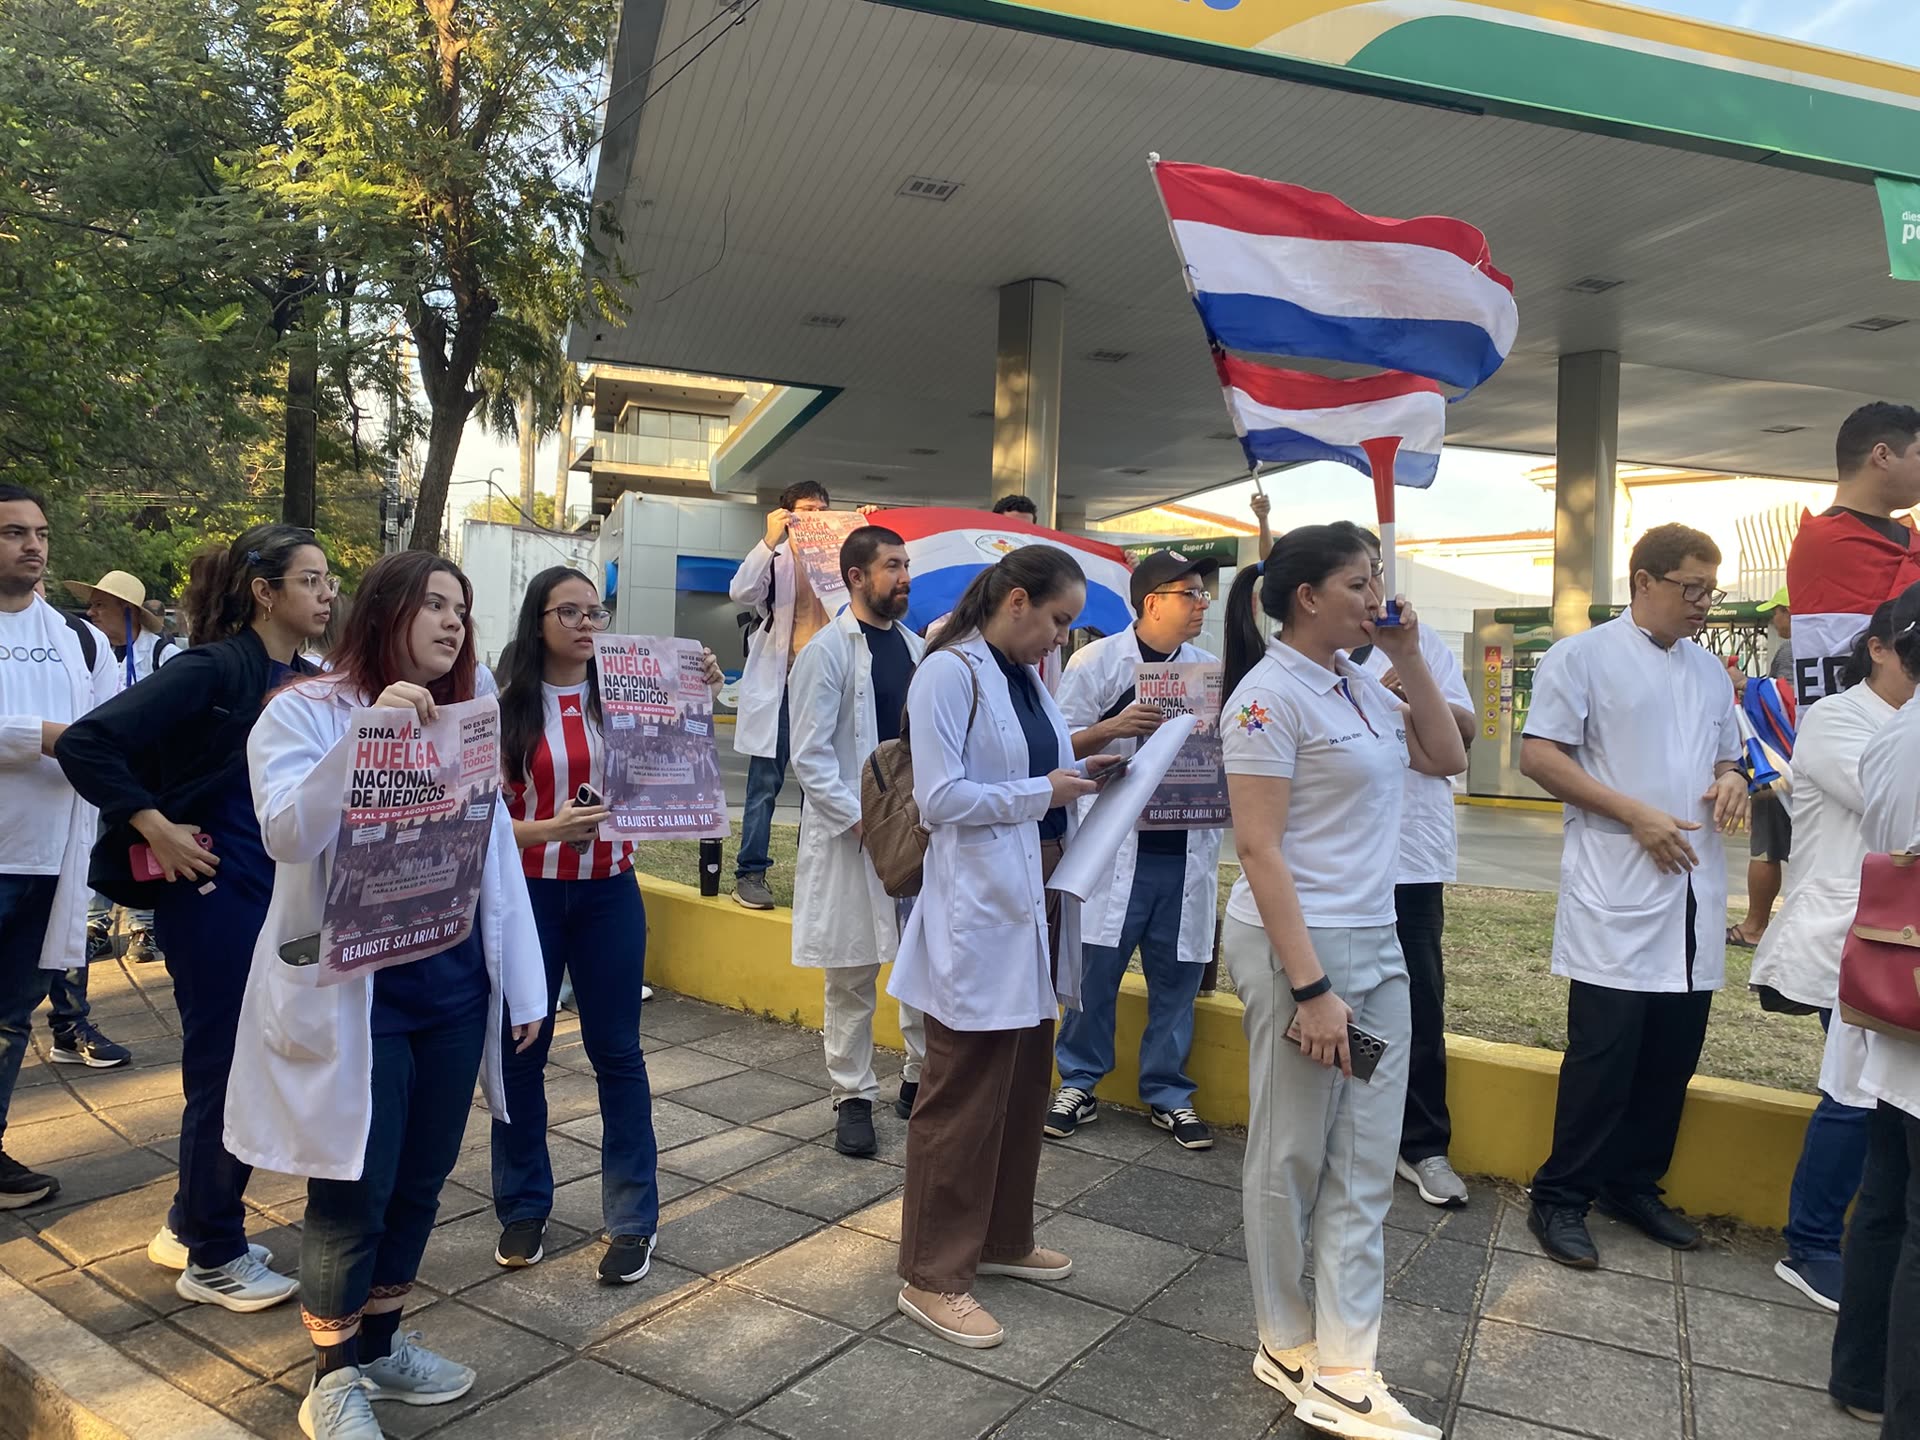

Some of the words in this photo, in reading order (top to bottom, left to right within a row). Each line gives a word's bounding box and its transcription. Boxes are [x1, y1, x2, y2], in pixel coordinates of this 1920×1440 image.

[1182, 543, 1203, 552] Super
[1204, 542, 1215, 550] 97
[824, 580, 845, 591] REAJUS
[1707, 608, 1737, 617] Podium
[600, 642, 650, 656] SINAMED
[602, 655, 663, 677] HUELGA
[603, 674, 660, 691] NACIONAL
[1139, 669, 1180, 682] SINAMED
[1140, 681, 1187, 697] HUELGA
[605, 688, 620, 701] DE
[623, 688, 669, 705] MEDICOS
[1140, 697, 1185, 708] NACIONAL
[1161, 708, 1195, 719] EDICOS
[358, 720, 421, 742] SINAME
[474, 726, 485, 734] POR
[355, 741, 440, 770] HUELGA
[463, 748, 474, 760] ES
[477, 742, 494, 755] POR
[352, 769, 435, 789] NACIONAL
[350, 789, 373, 808] DE
[378, 784, 446, 808] MEDICOS
[351, 812, 362, 820] 24
[365, 812, 376, 820] AL
[391, 810, 403, 818] DE
[616, 815, 657, 827] REAJUSTE
[657, 814, 697, 827] SALARIAL
[699, 813, 714, 825] YA!
[1149, 809, 1181, 820] REAJUSTE
[1182, 809, 1213, 819] SALARIAL
[1215, 808, 1226, 818] YA!
[341, 936, 391, 963] REAJUSTE
[392, 926, 440, 949] SALARIAL
[443, 920, 459, 937] YA!
